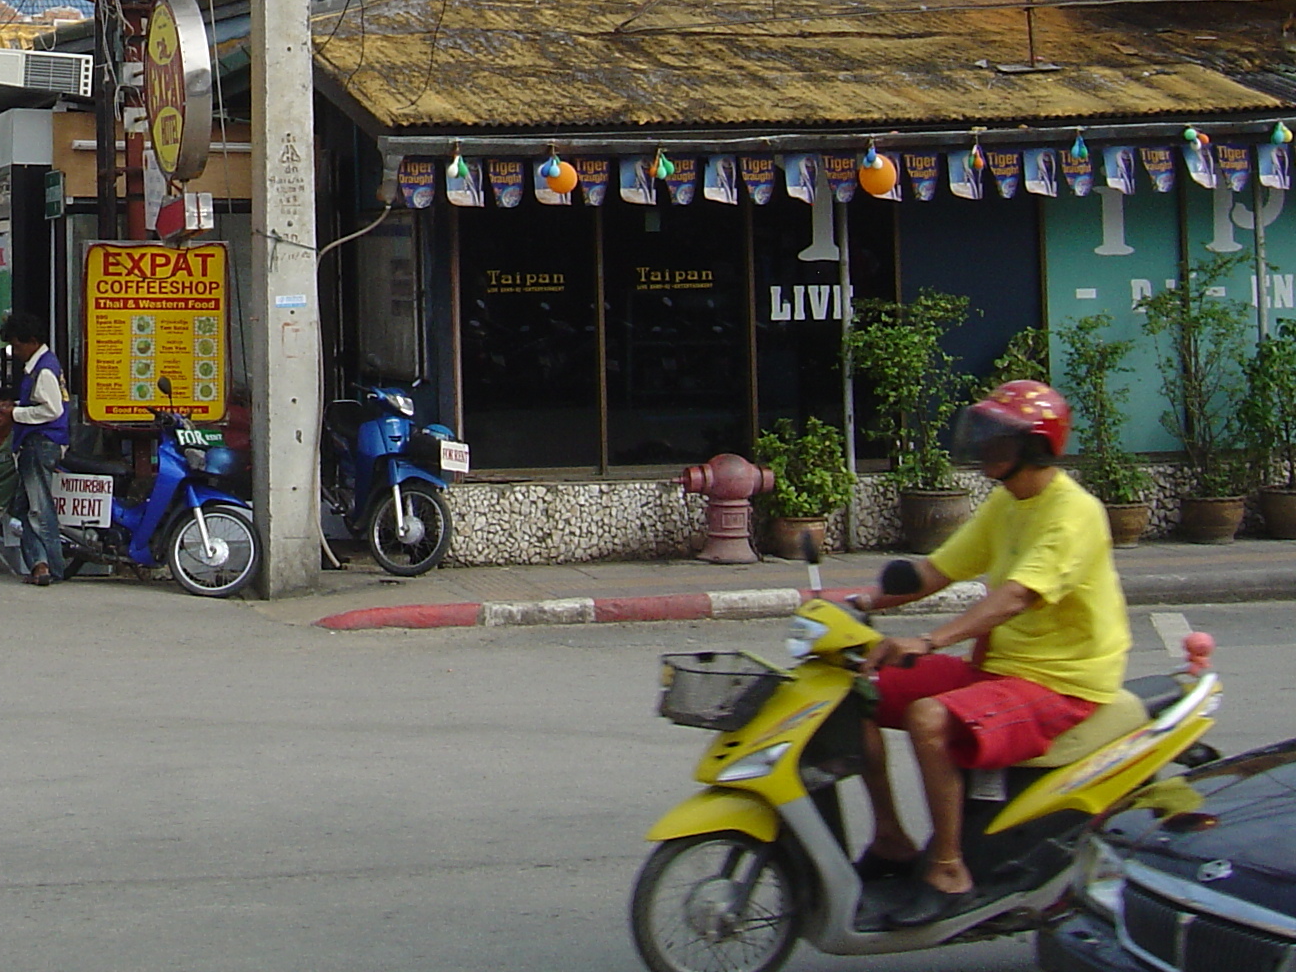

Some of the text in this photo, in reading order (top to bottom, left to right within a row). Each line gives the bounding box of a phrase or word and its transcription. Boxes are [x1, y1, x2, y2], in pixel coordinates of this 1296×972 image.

[160, 113, 179, 147] HOTEL
[988, 152, 1018, 168] Tiger
[1141, 148, 1171, 162] Tiger
[1217, 145, 1248, 160] Tiger
[400, 159, 433, 174] Tiger
[489, 158, 521, 174] Tiger
[576, 158, 608, 173] Tiger
[742, 157, 774, 172] Tiger
[823, 155, 855, 171] Tiger
[905, 154, 937, 170] Tiger
[102, 252, 216, 278] EXPAT
[487, 269, 565, 286] Taipan
[636, 267, 713, 283] Taipan
[96, 280, 220, 295] COFFEESHOP
[98, 299, 215, 308] Thai & Western Food
[176, 429, 222, 446] FOR RENT
[60, 478, 112, 495] MOTORBIKE
[72, 498, 103, 517] RENT
